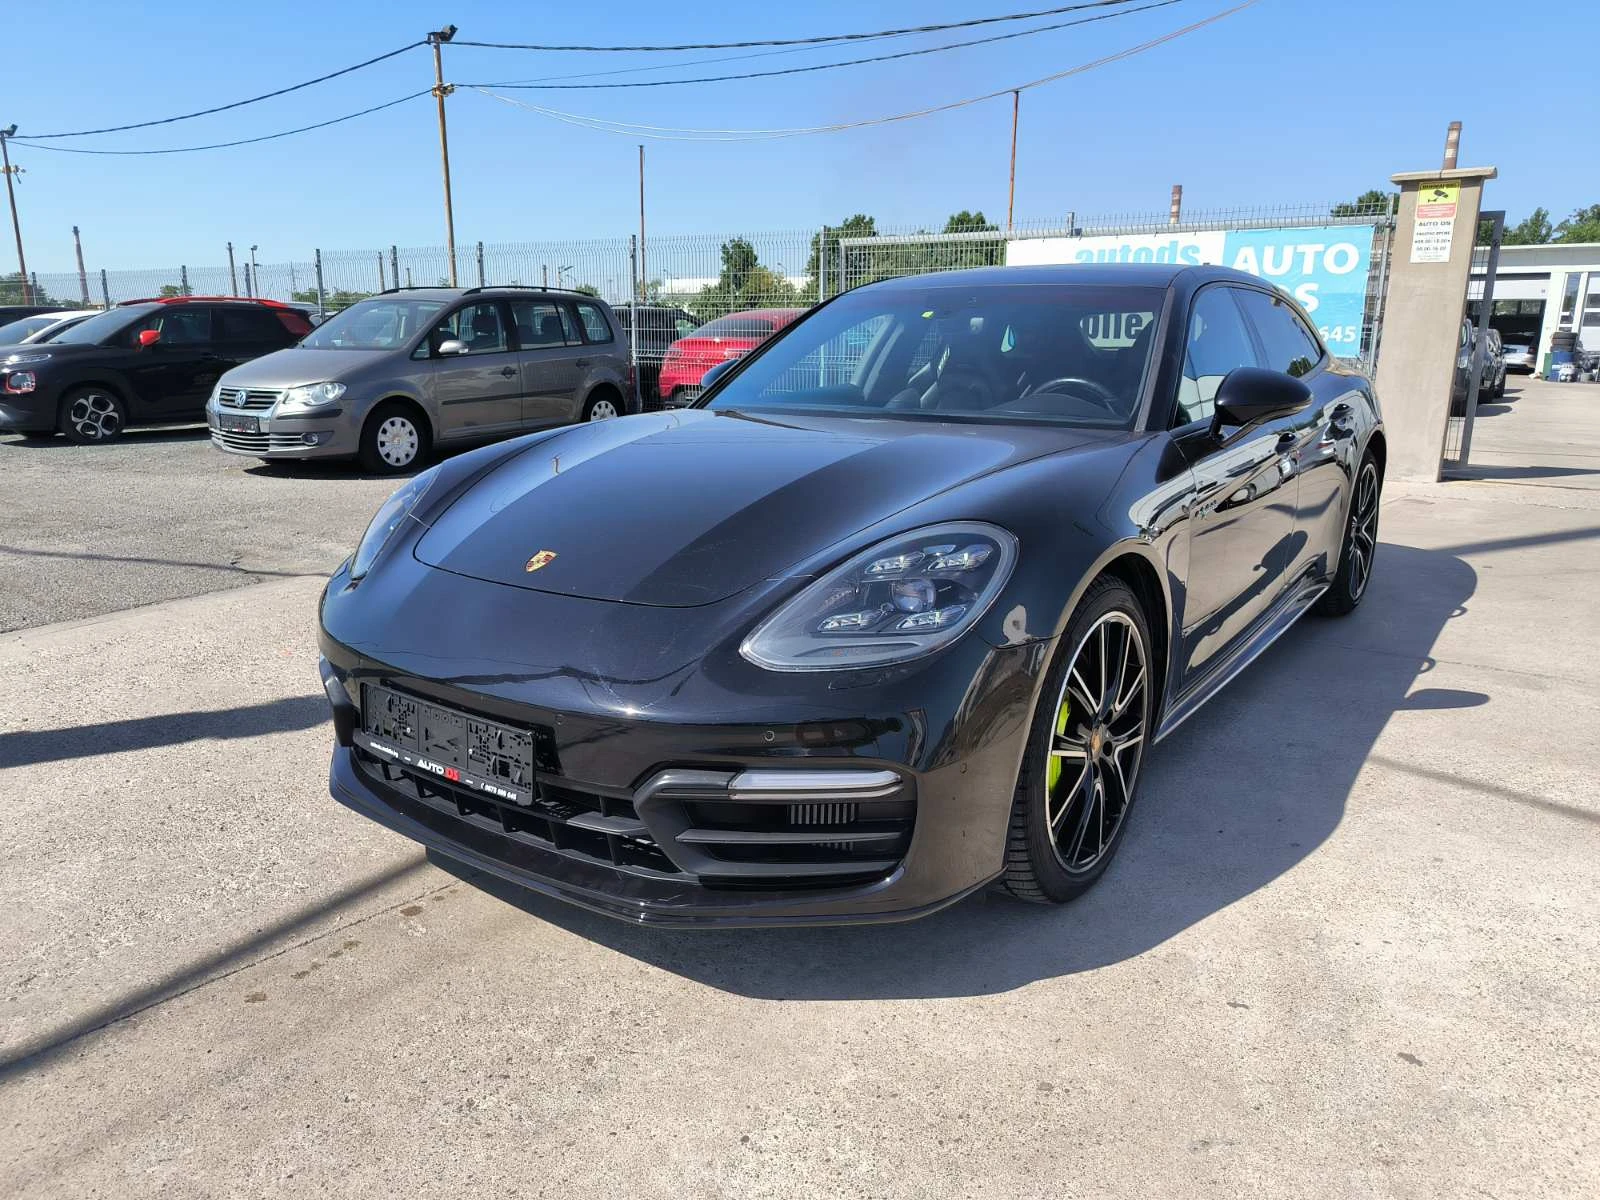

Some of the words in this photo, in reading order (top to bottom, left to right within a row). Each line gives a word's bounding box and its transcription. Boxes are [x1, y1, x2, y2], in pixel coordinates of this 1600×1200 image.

[1228, 242, 1360, 277] AUTO
[417, 759, 444, 775] AUTO
[445, 767, 460, 781] DS
